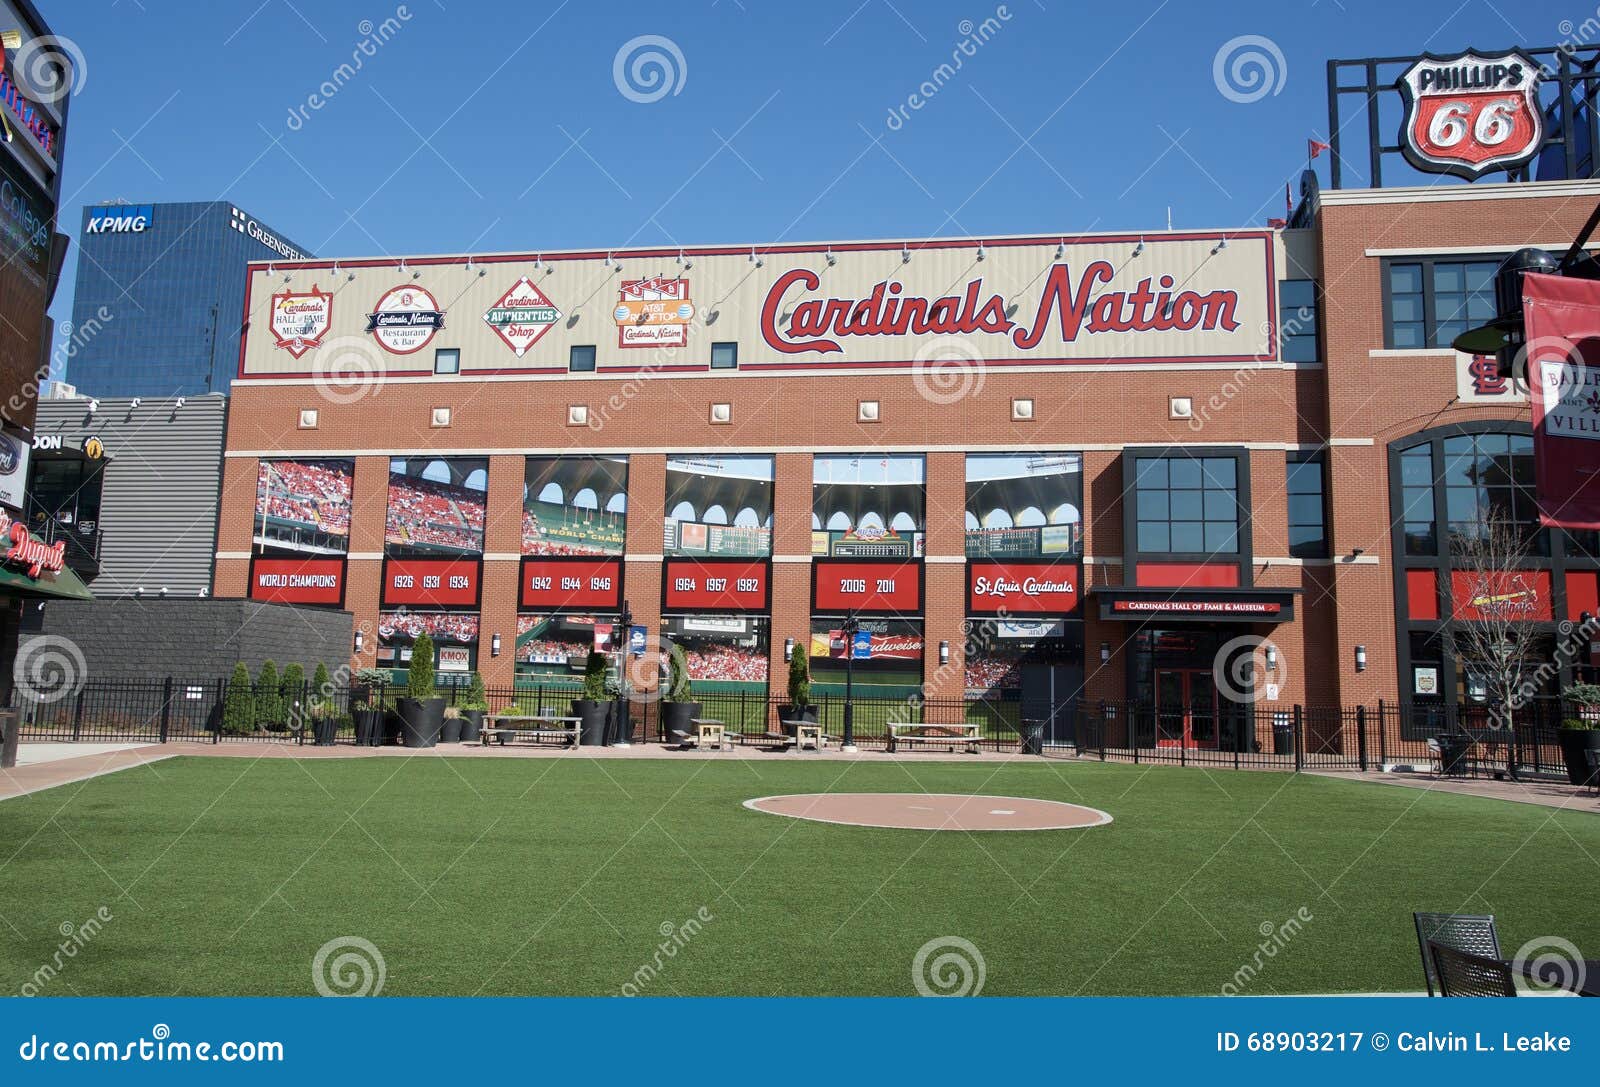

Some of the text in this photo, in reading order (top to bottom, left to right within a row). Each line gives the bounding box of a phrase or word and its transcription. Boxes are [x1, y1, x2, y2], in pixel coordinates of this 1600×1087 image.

[1420, 63, 1513, 91] PHILLIPS
[1428, 98, 1518, 147] 66
[1, 180, 48, 247] College
[87, 216, 146, 233] KPMG
[283, 298, 324, 314] Cardinals
[502, 294, 547, 308] Cardinals
[641, 303, 666, 313] AT&T
[761, 260, 1241, 354] Cardinals Nation
[276, 315, 297, 324] HALL
[303, 314, 326, 324] FAME
[376, 313, 435, 326] Cardinals Nation
[490, 310, 554, 322] AUTHENTICS
[630, 312, 678, 323] ROOFTOP
[282, 326, 317, 335] MUSEUM
[382, 329, 427, 338] Restaurant
[508, 323, 535, 339] Shop
[625, 327, 681, 341] Cardinals Nation
[402, 338, 416, 346] Bar
[548, 528, 586, 539] WORLD
[259, 574, 336, 588] WORLD CHAMPIONS
[394, 575, 469, 589] 1926 1931 1934
[532, 576, 611, 591] 1942 1944 1946
[675, 577, 758, 592] 1964 1967 1982
[840, 579, 895, 593] 2006 2011
[974, 576, 1074, 597] St. Louis Cardinals
[1128, 602, 1170, 610] CARDINALS
[1171, 603, 1191, 611] HALL
[870, 639, 922, 652] udweise
[440, 651, 468, 661] KMOX
